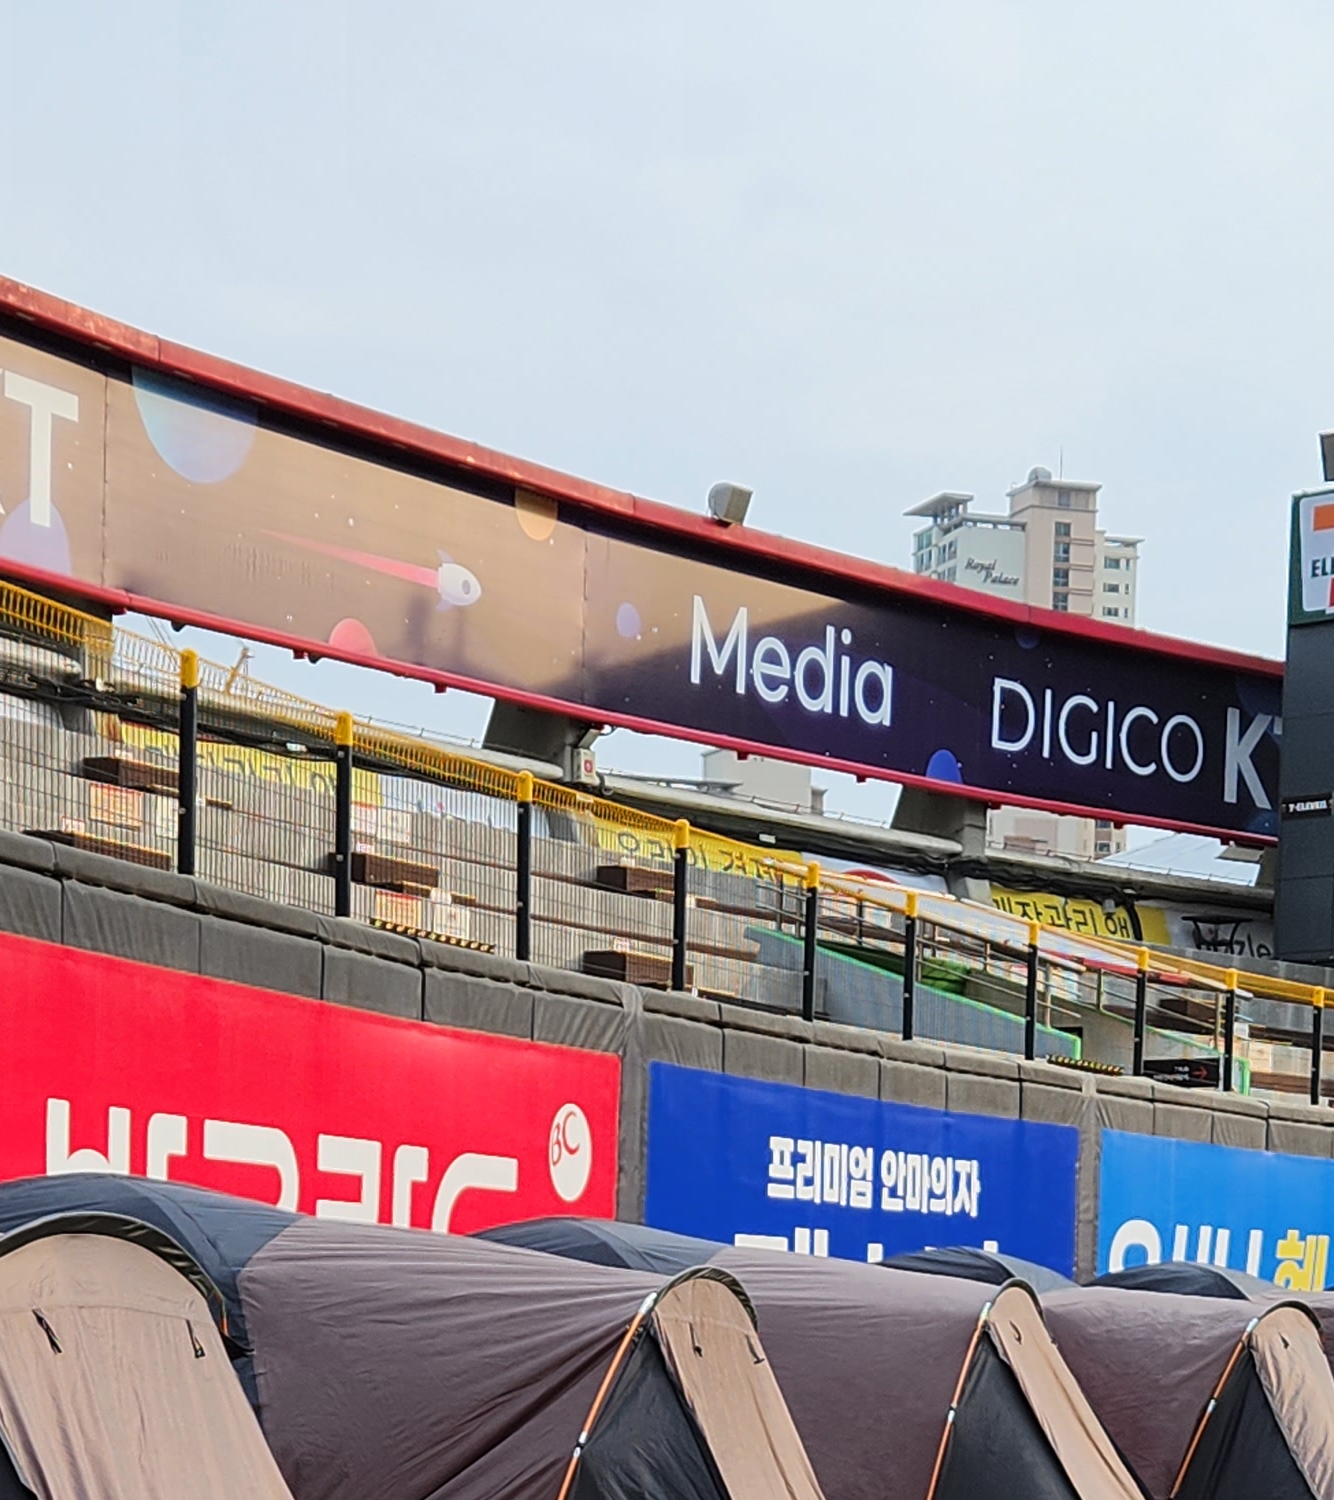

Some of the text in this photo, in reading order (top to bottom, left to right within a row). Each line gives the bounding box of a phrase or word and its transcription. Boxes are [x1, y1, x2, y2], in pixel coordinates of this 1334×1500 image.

[965, 557, 997, 574] Royal
[983, 571, 1020, 586] Palace
[690, 594, 893, 727] Media
[991, 676, 1281, 810] DIGICO K
[767, 1136, 982, 1218] 프리미엄 안마의자
